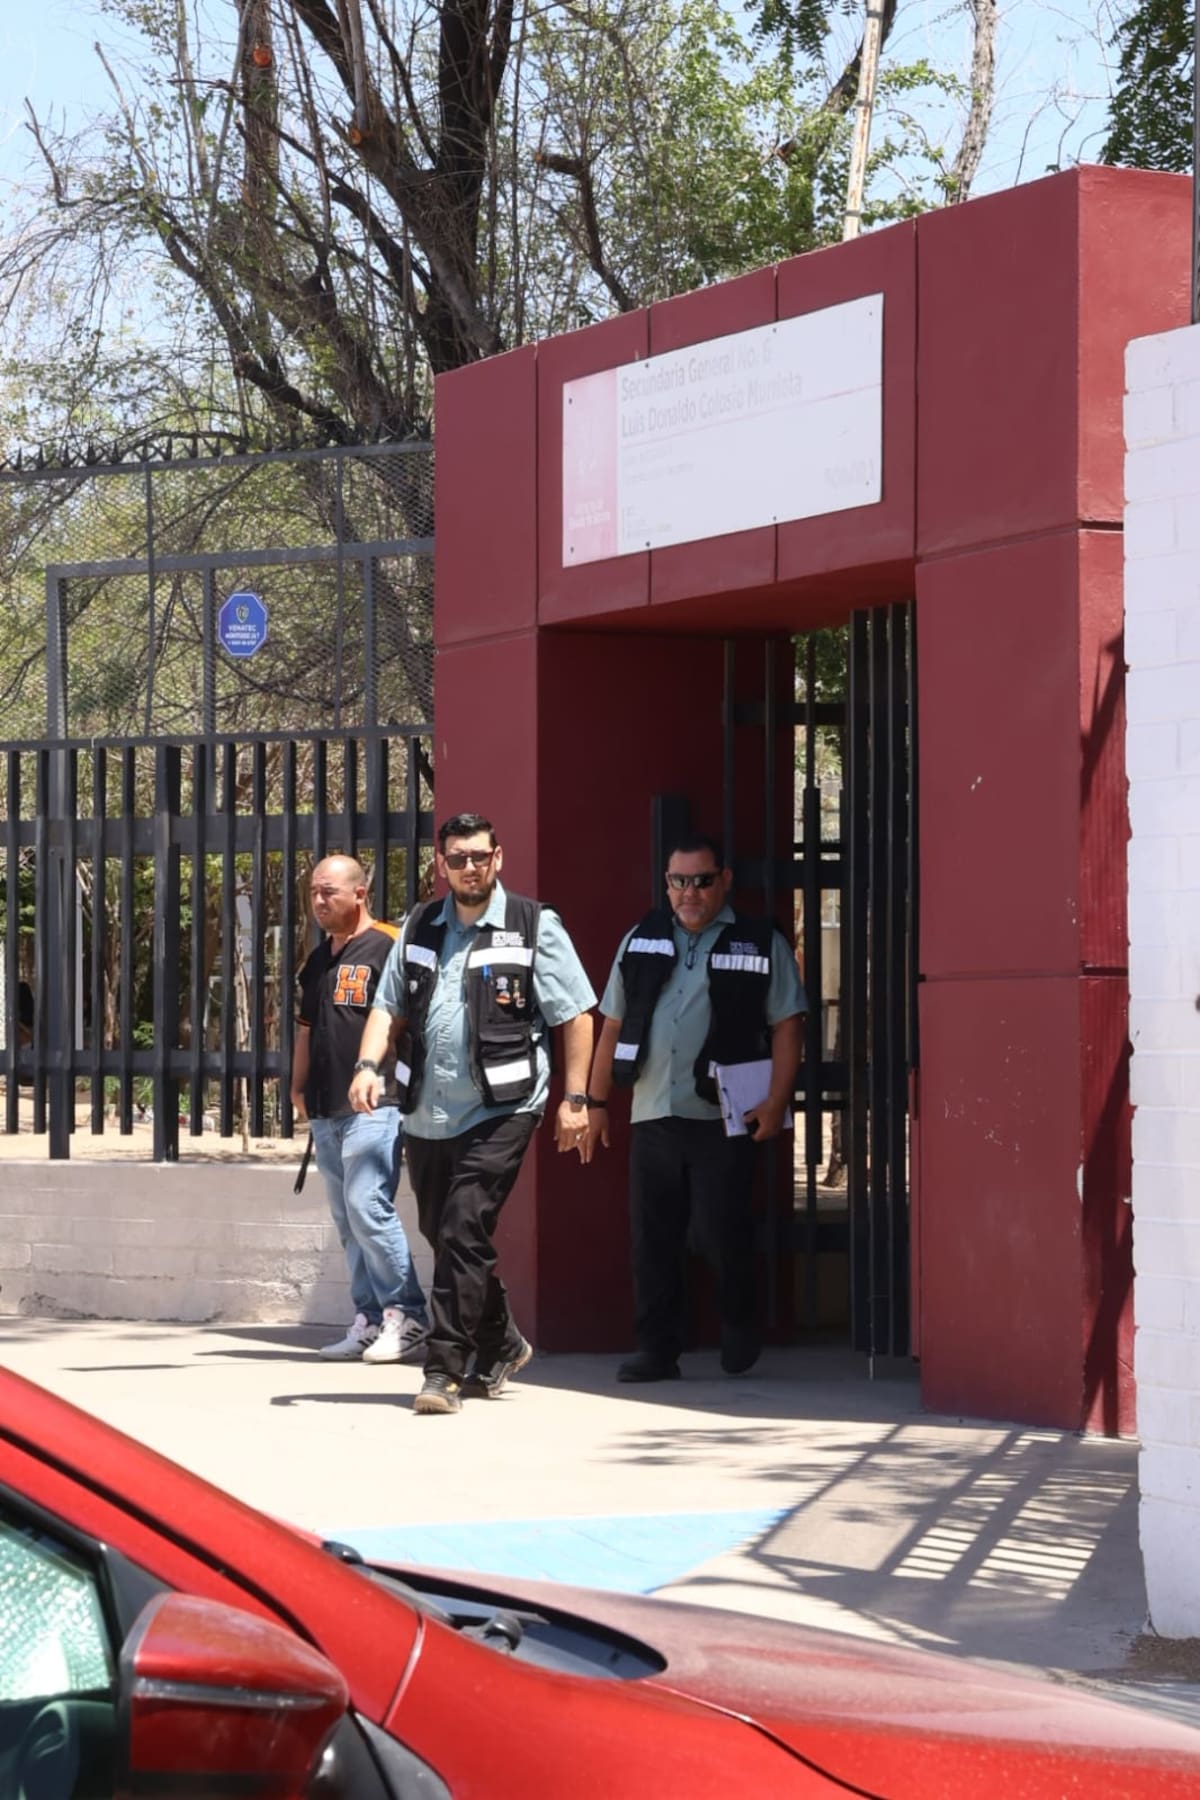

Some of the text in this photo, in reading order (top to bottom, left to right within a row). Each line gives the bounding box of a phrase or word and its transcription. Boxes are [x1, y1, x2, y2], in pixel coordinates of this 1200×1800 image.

[622, 361, 685, 401] Secundaria
[688, 345, 735, 383] General
[622, 409, 645, 438] Luis
[648, 397, 697, 431] Donaldo
[699, 384, 745, 419] Colosio
[333, 964, 371, 1008] H
